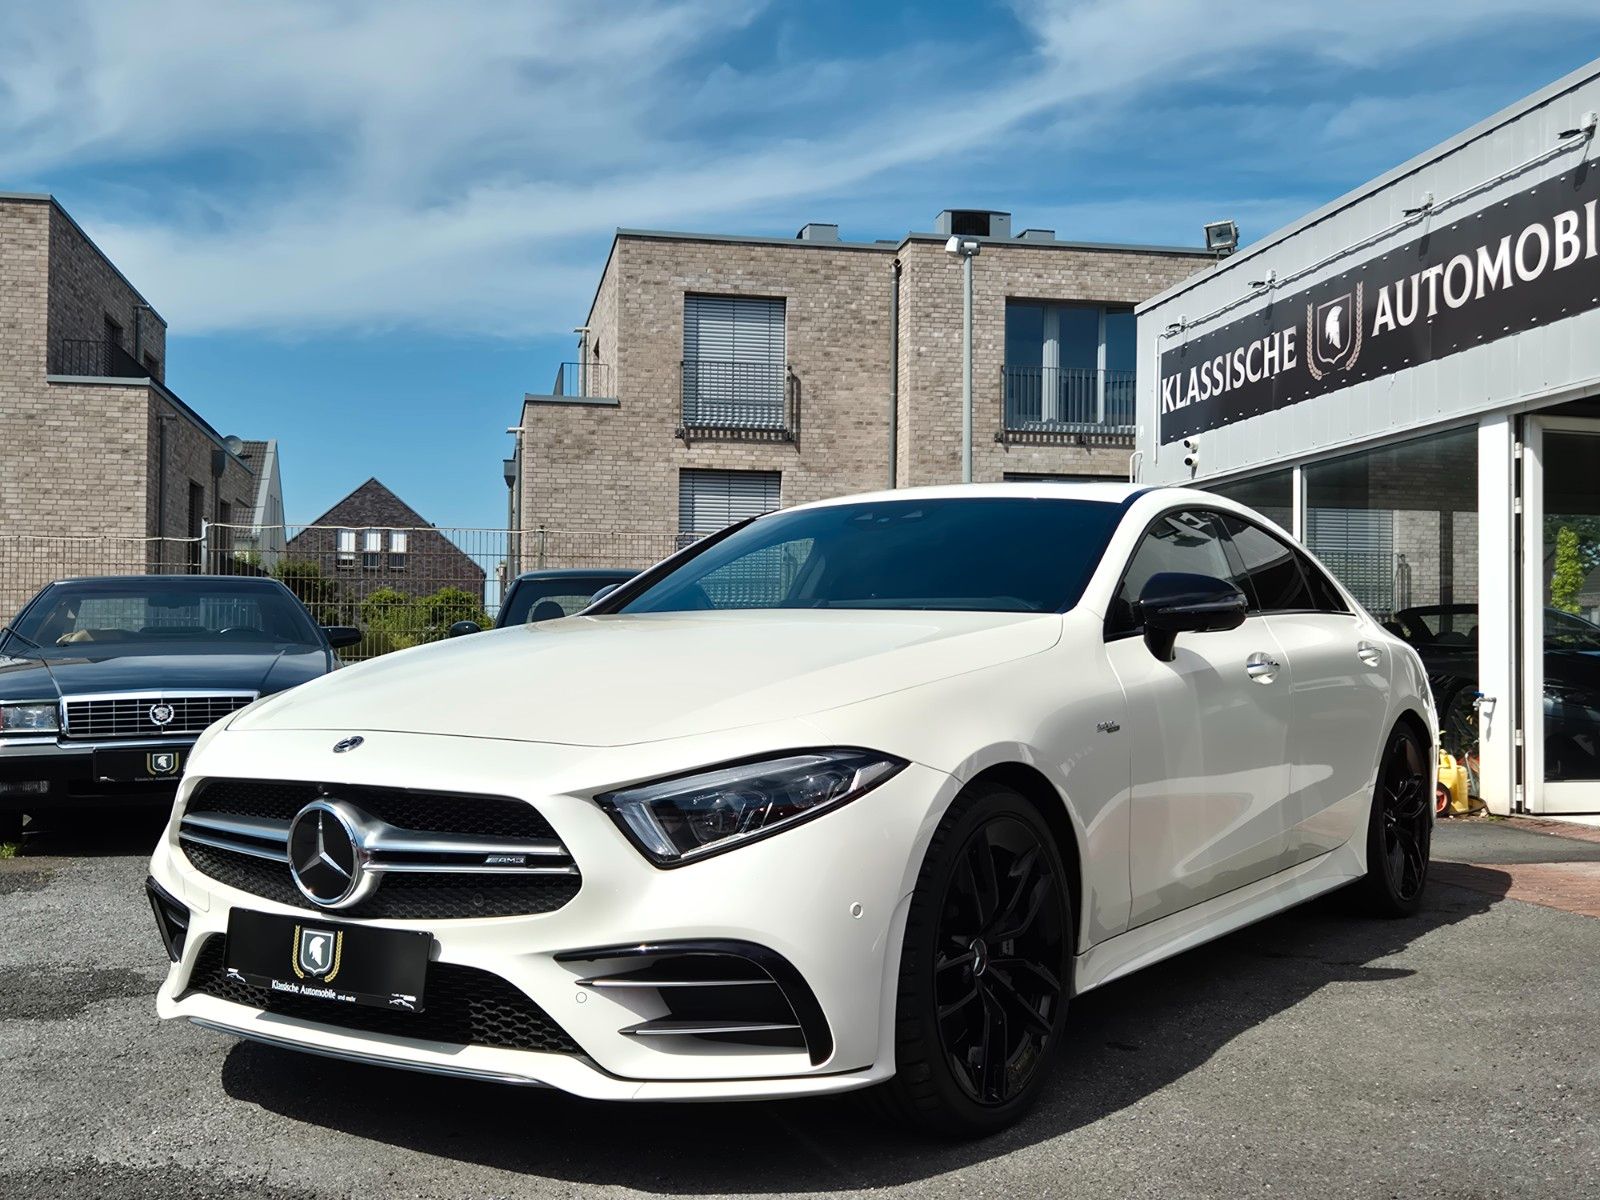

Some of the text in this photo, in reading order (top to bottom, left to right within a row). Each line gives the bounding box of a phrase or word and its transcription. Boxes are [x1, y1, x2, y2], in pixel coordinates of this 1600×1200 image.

[1162, 199, 1598, 414] KLASSISCHE AUTOMOBI
[272, 979, 300, 993] Klassische
[300, 985, 336, 999] Automobile
